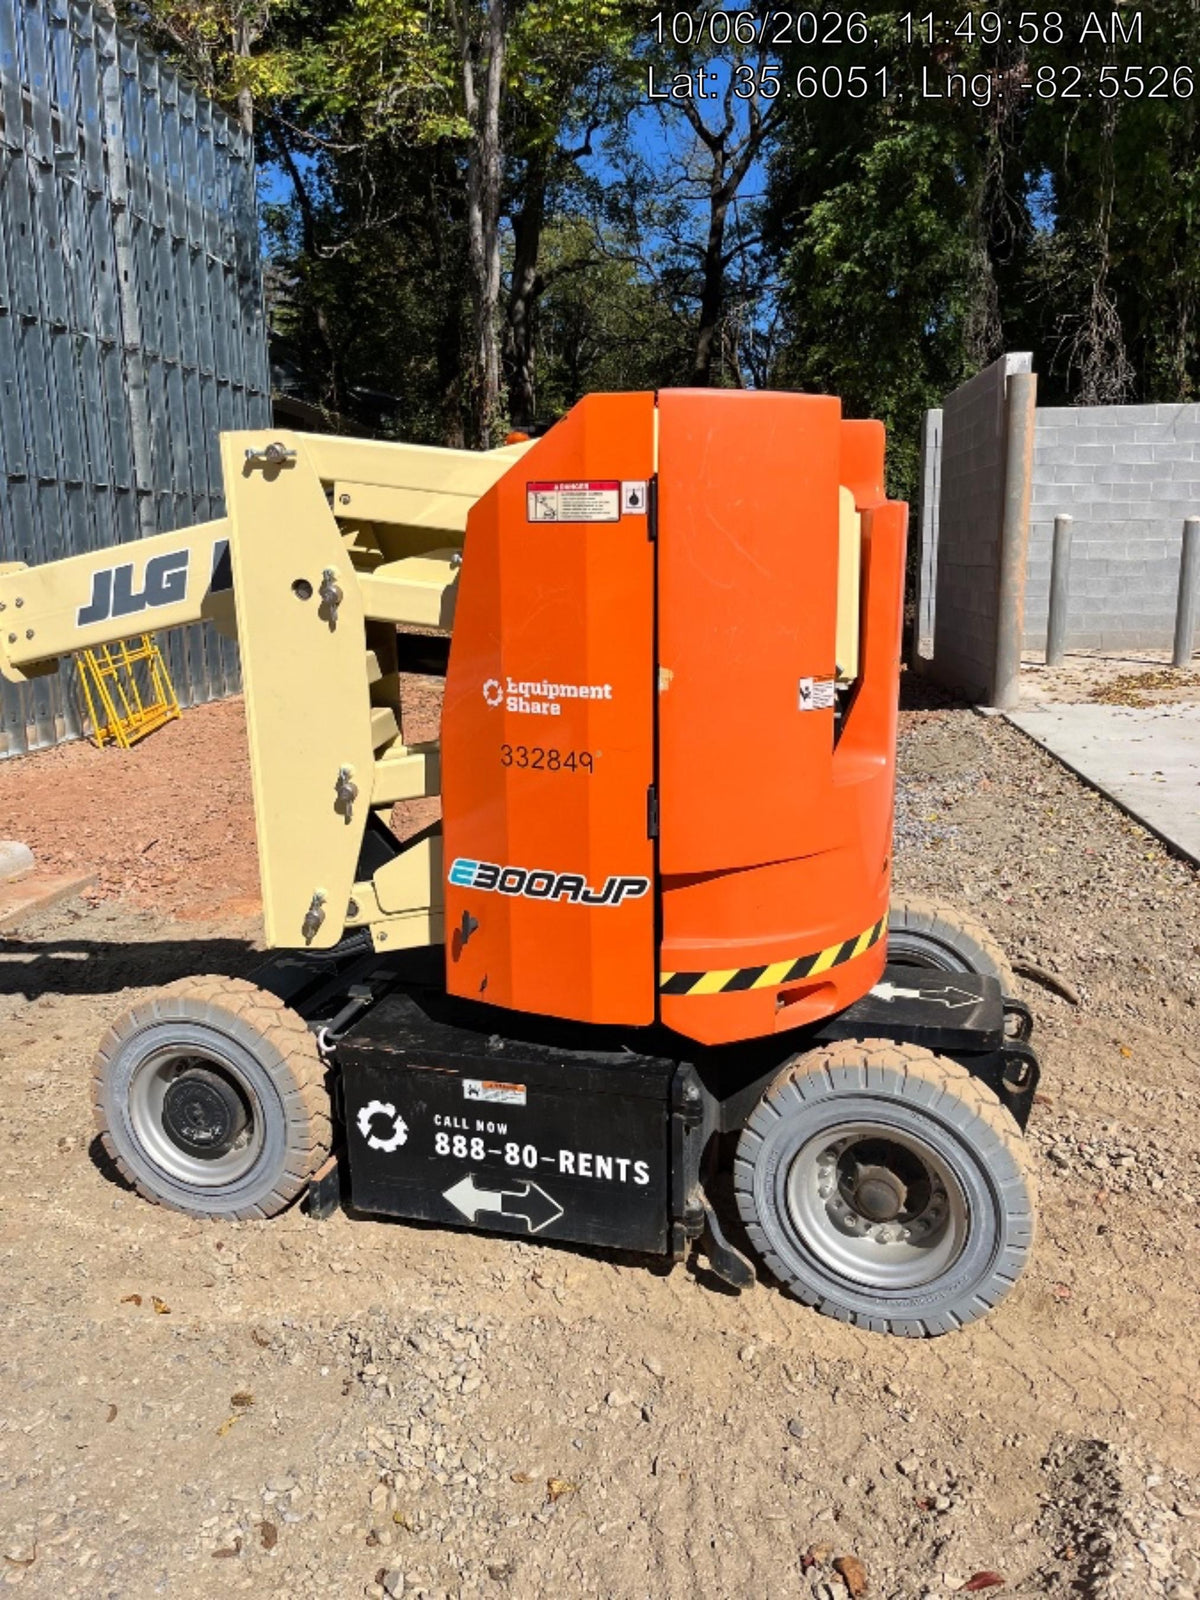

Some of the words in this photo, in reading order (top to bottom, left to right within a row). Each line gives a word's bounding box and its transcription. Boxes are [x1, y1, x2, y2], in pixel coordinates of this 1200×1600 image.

[75, 549, 190, 628] JLG
[506, 677, 613, 699] Equipment
[506, 697, 561, 716] Share
[500, 744, 594, 774] 332849
[448, 857, 650, 907] E300AJP
[434, 1114, 470, 1130] CALL
[476, 1119, 508, 1135] NOW
[434, 1132, 650, 1185] 888-80-RENTS
